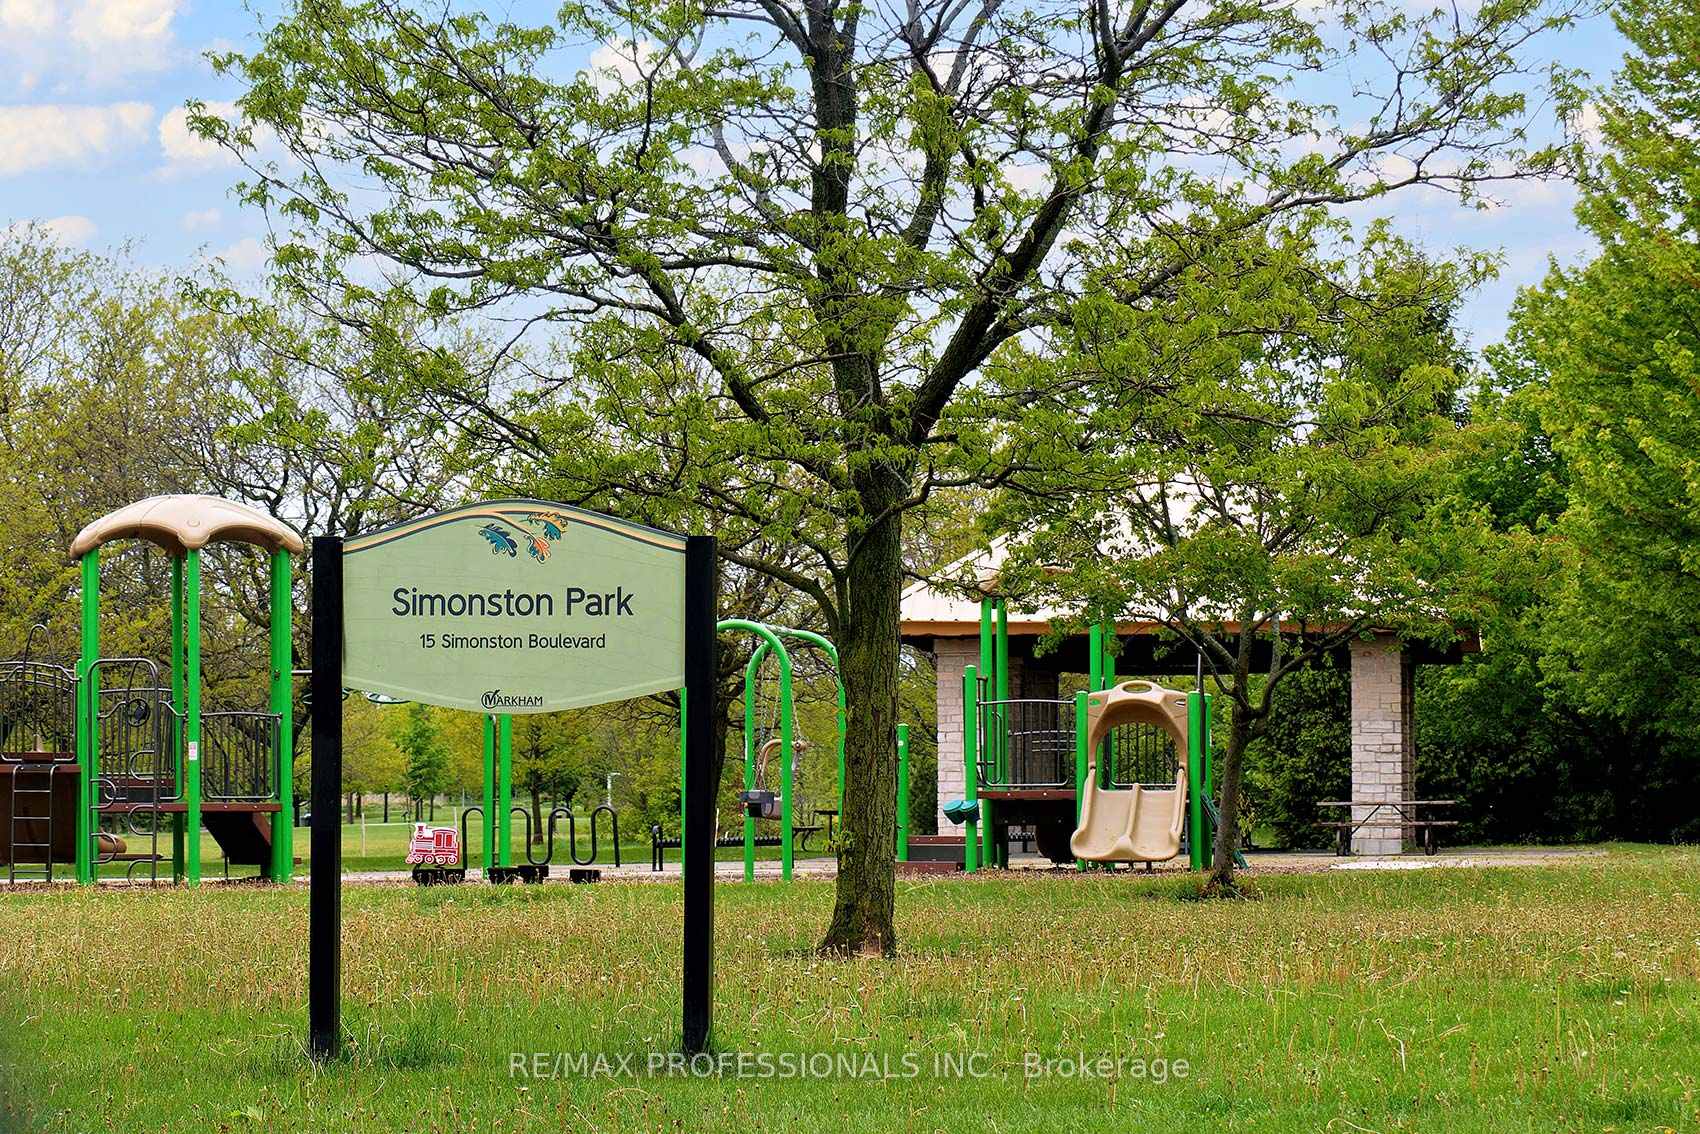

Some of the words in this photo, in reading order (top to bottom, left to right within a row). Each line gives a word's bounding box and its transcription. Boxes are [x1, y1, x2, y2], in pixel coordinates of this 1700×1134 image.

[391, 587, 553, 617] Simonston
[566, 586, 634, 617] Park
[419, 634, 436, 649] 15
[441, 633, 523, 649] Simonston
[528, 633, 606, 649] Boulevard
[480, 689, 543, 710] MARKHAM
